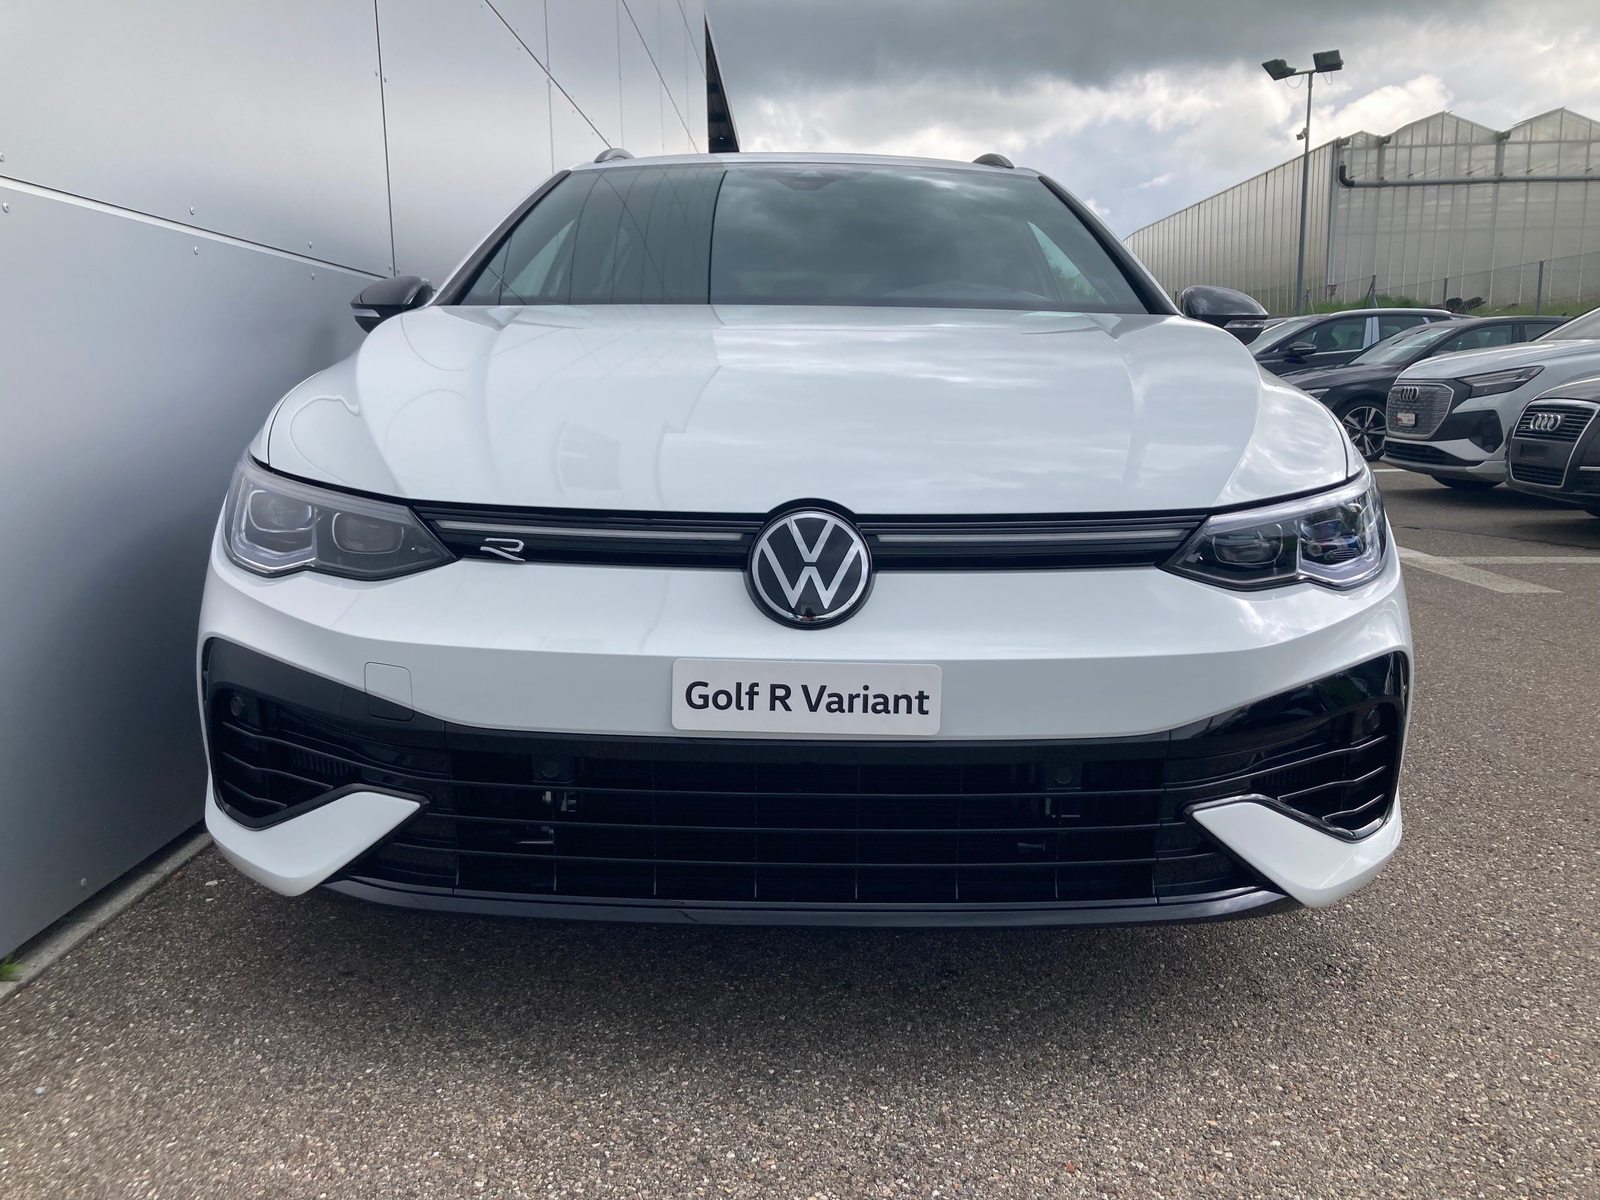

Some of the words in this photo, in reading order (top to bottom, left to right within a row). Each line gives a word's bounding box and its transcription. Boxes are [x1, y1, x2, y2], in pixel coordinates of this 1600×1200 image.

[480, 537, 525, 562] R
[758, 514, 864, 611] VW
[685, 681, 760, 712] Golf
[769, 683, 793, 712] R
[801, 684, 930, 715] Variant
